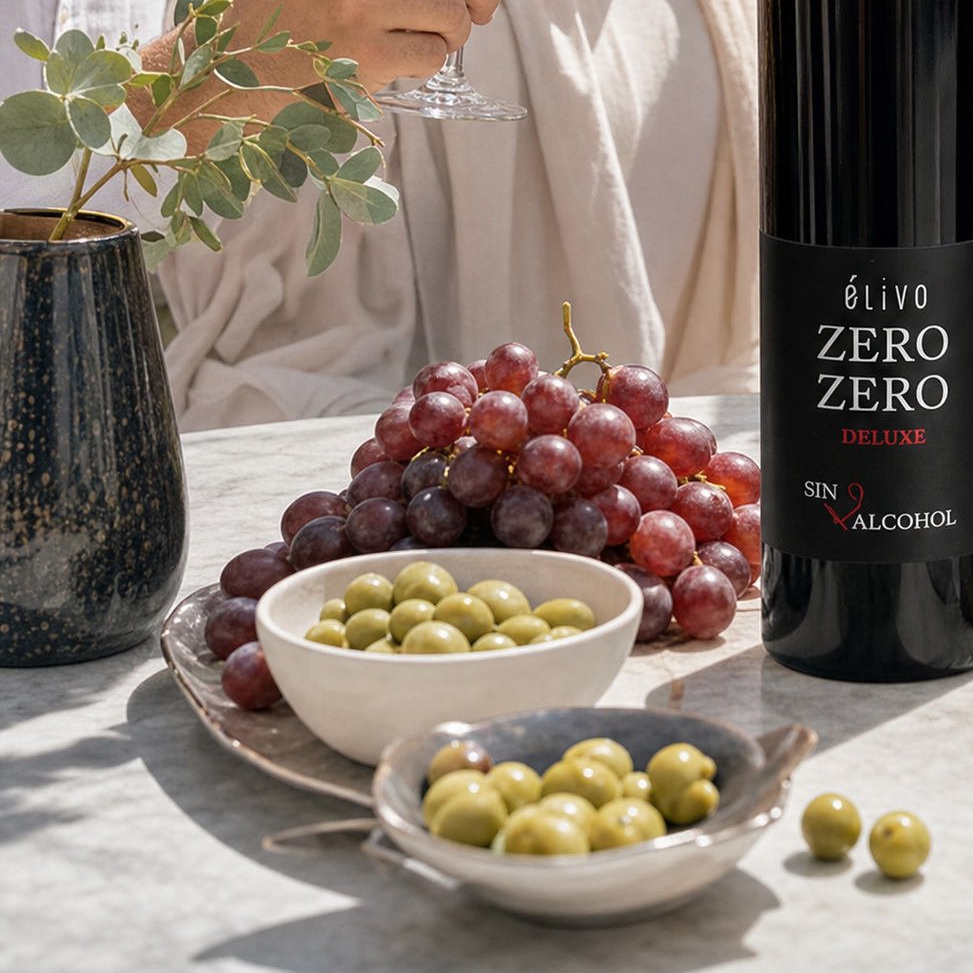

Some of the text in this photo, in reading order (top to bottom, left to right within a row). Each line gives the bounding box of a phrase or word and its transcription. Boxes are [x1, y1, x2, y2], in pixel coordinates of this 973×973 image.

[817, 324, 949, 362] ZERO
[817, 374, 949, 412] ZERO
[841, 428, 927, 446] DELUXE
[804, 480, 838, 501] SIN
[852, 509, 957, 531] ALCOHOL
